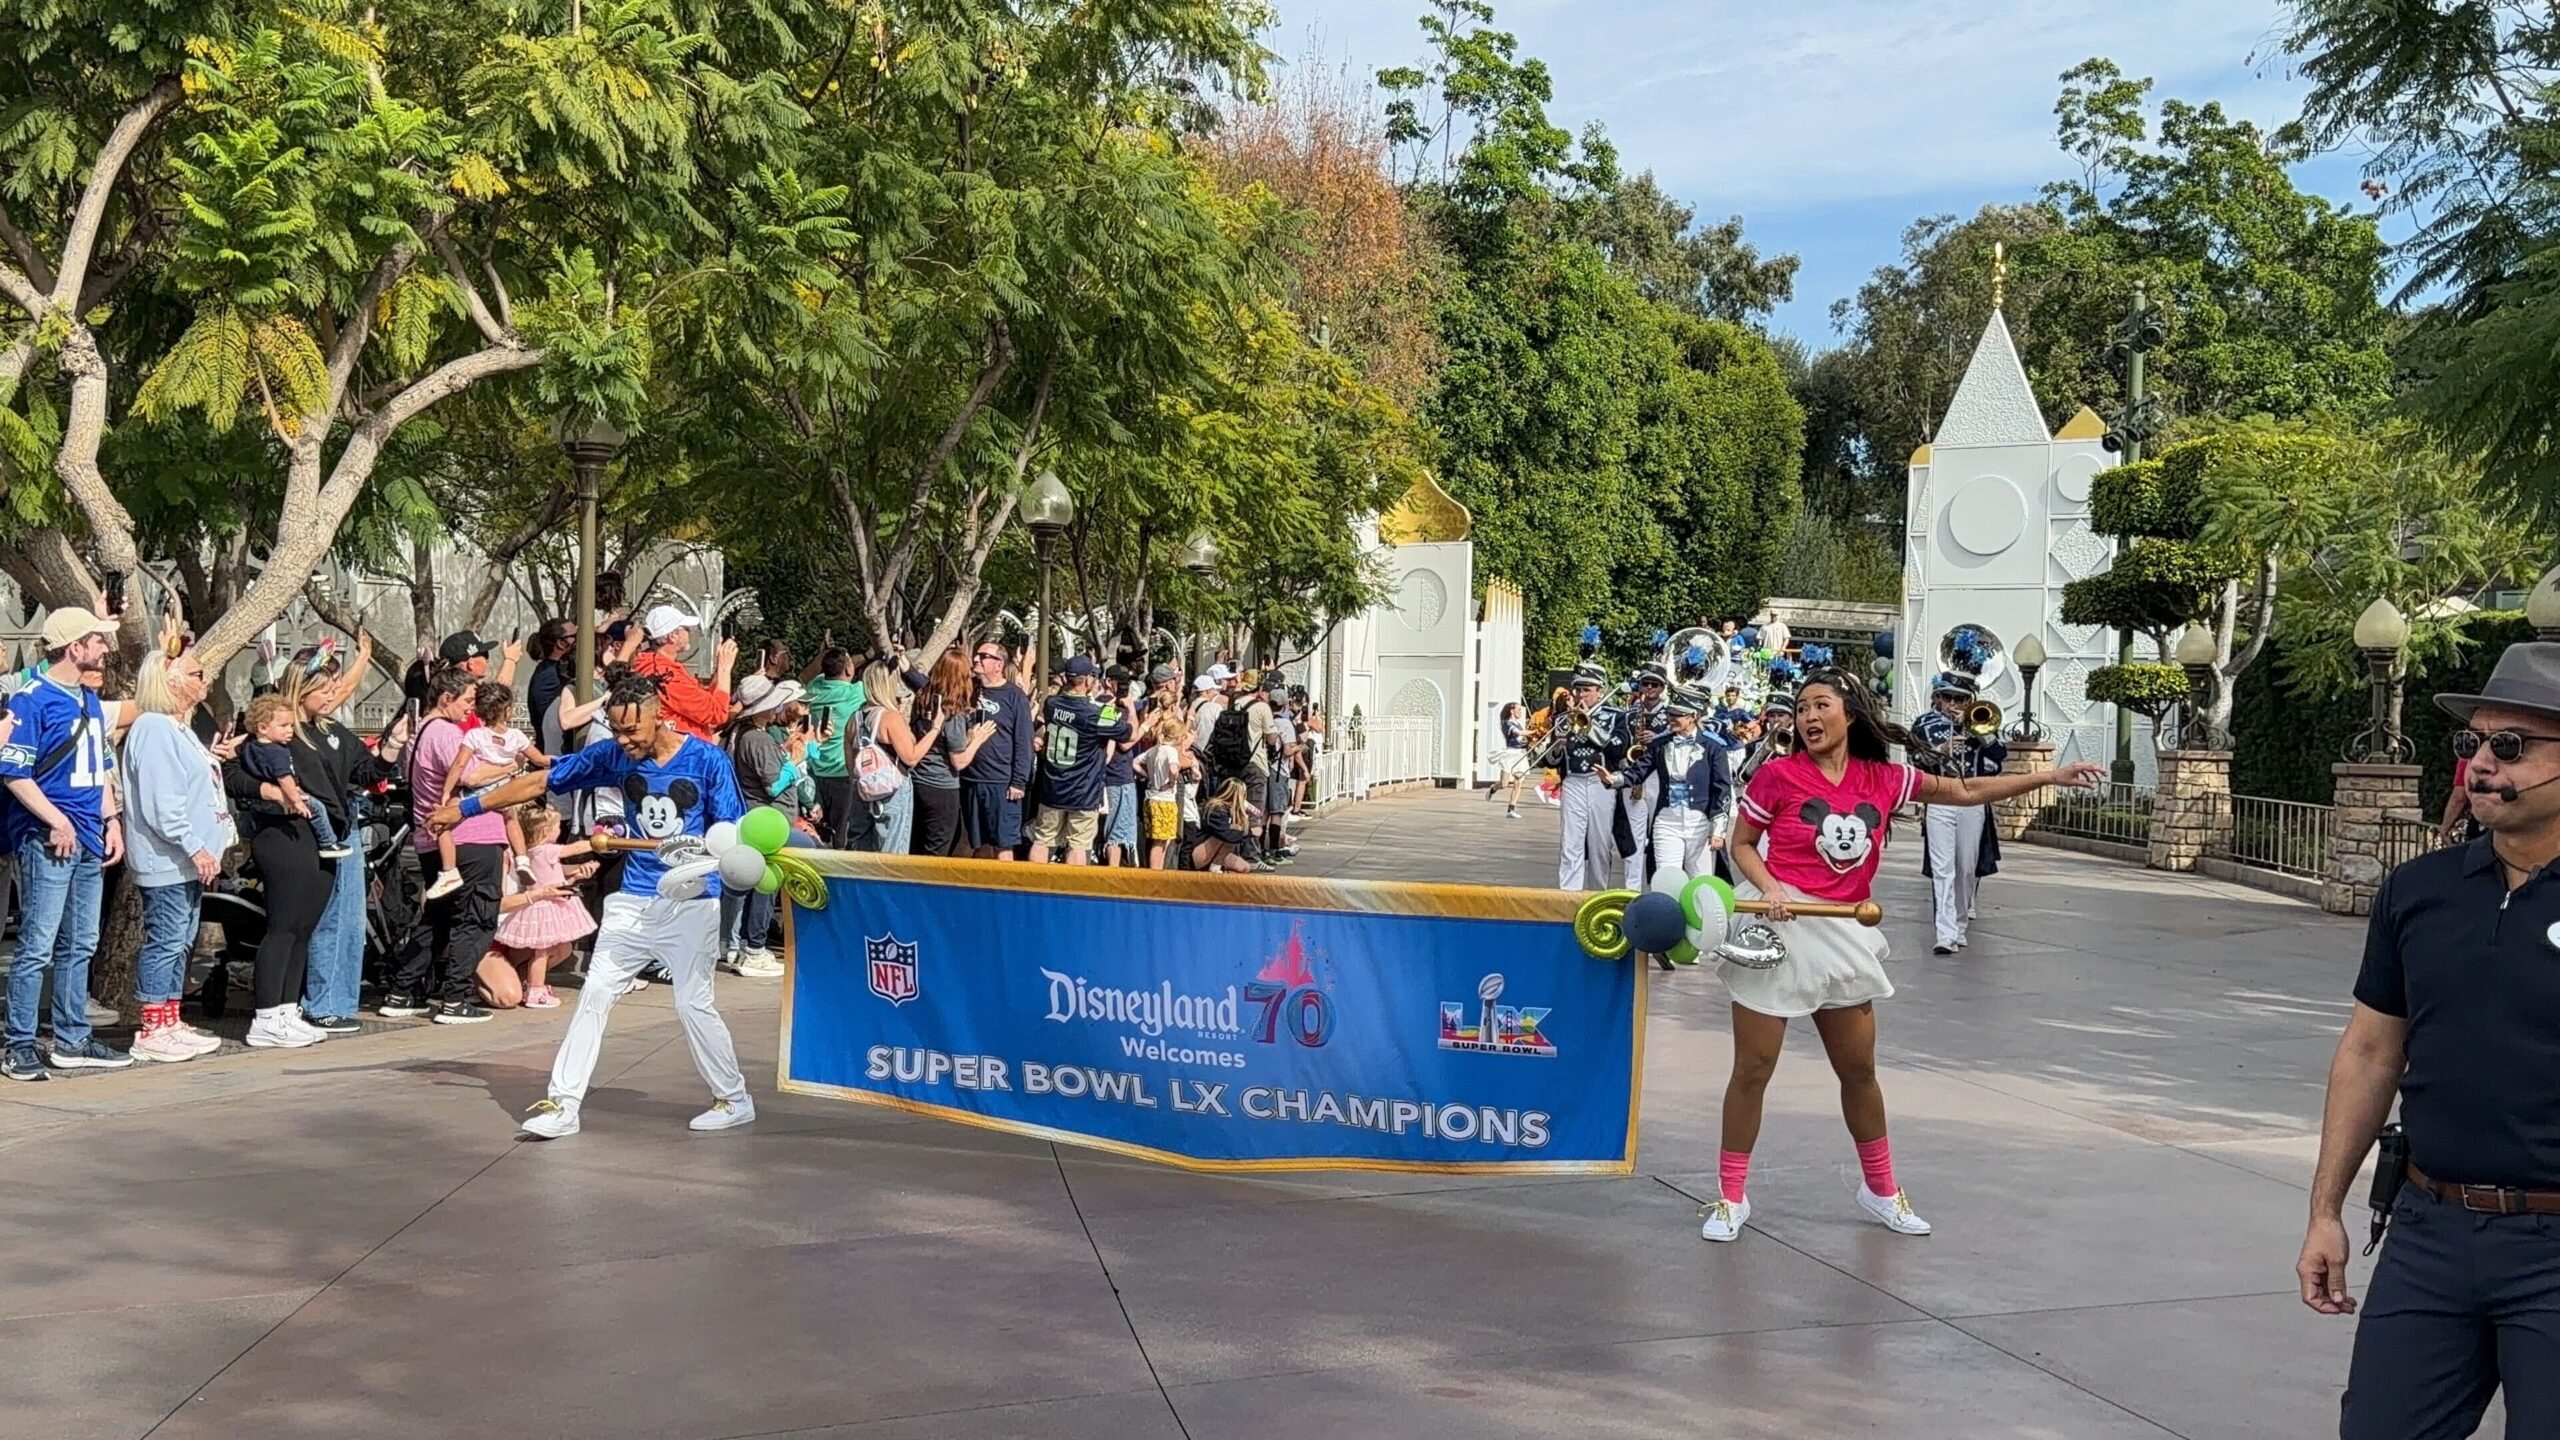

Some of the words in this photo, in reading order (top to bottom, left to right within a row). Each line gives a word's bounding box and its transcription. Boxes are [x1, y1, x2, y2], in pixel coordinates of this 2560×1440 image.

[1053, 708, 1076, 723] KUPP
[70, 717, 105, 788] 11
[1046, 723, 1079, 767] 10
[874, 963, 914, 996] NFL
[1040, 966, 1241, 1036] Disneyland
[1244, 981, 1336, 1048] 70
[1120, 1036, 1246, 1068] Welcomes
[1198, 1031, 1238, 1041] RESORT
[1452, 1041, 1497, 1052] SUPER
[1503, 1045, 1542, 1055] BOWL
[865, 1045, 1013, 1091] SUPER
[1022, 1061, 1157, 1108] BOWL
[1169, 1079, 1232, 1118] LX
[1241, 1086, 1550, 1148] CHAMPIONS
